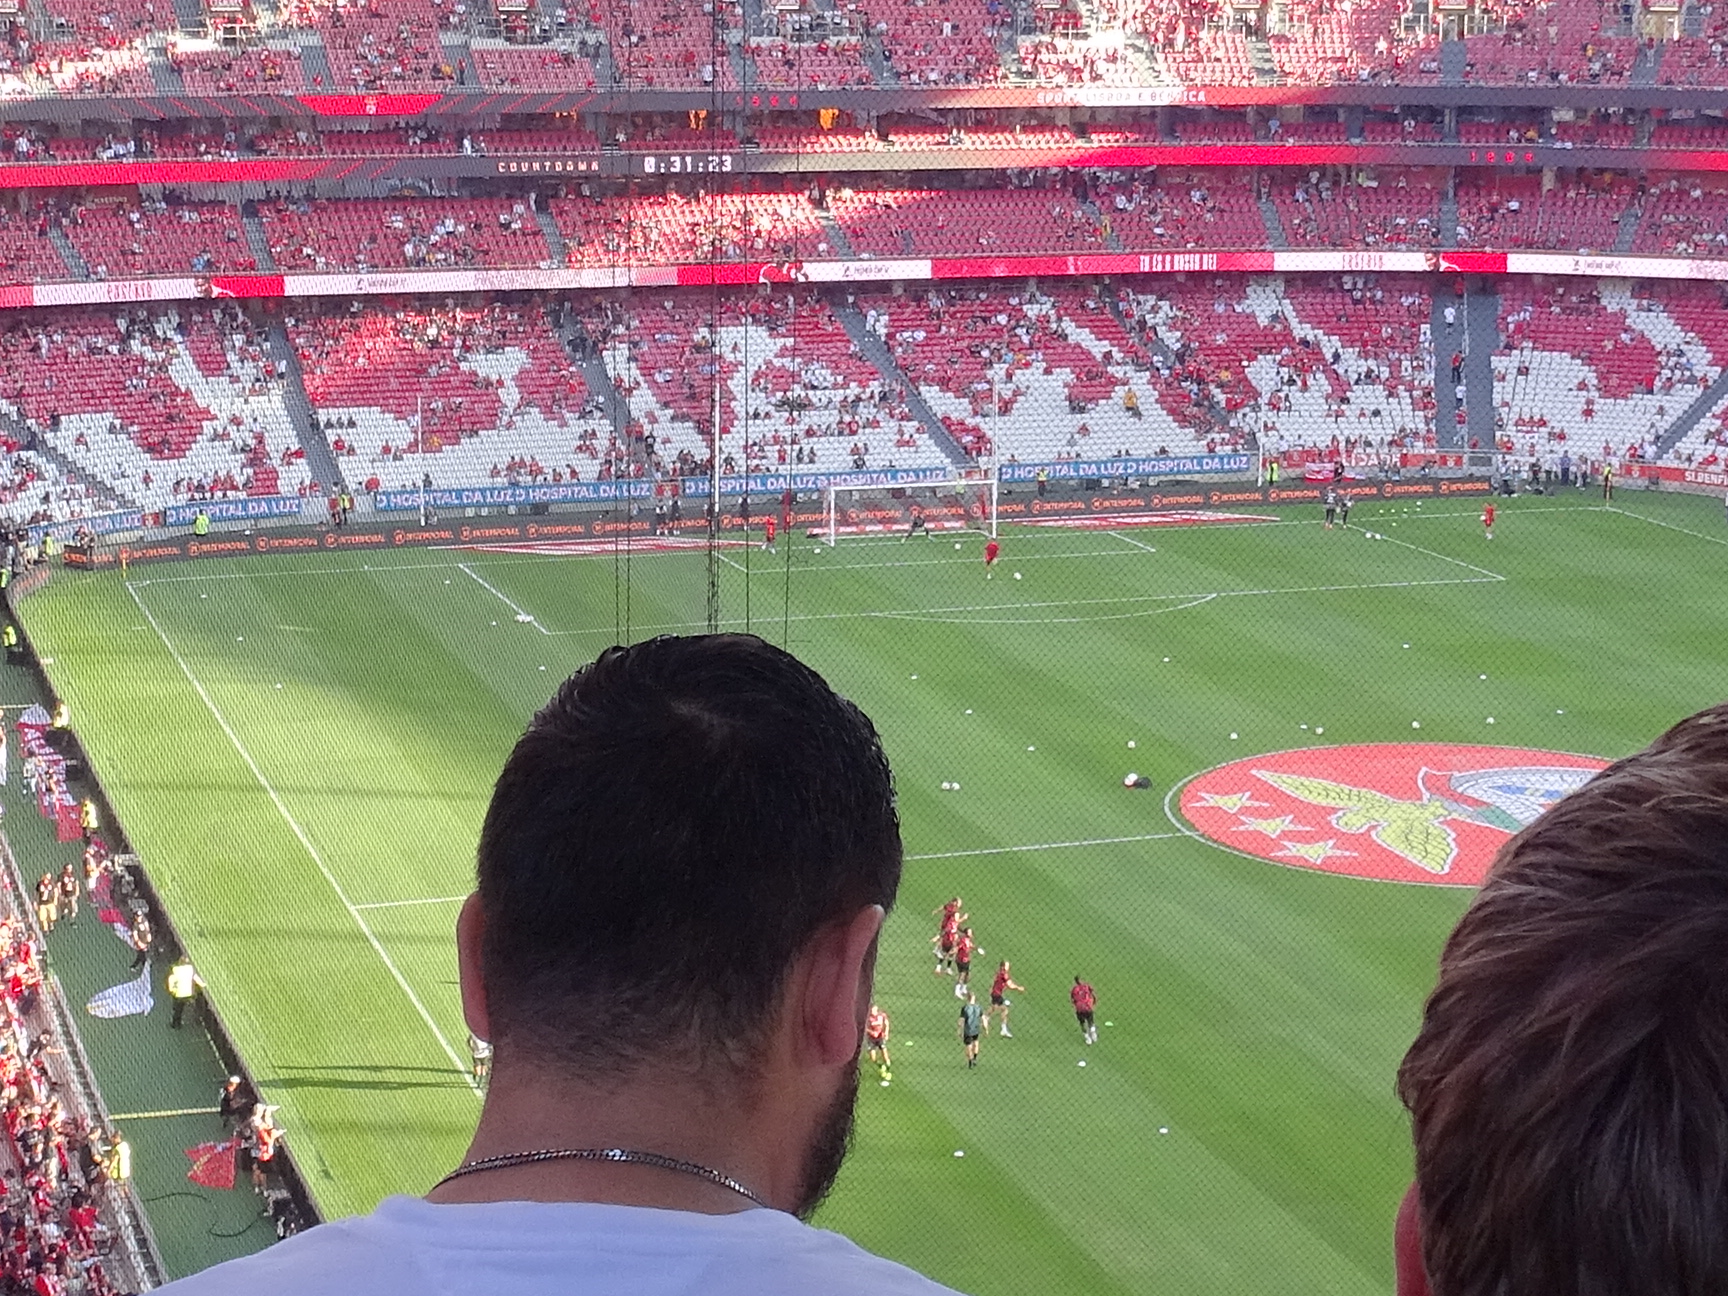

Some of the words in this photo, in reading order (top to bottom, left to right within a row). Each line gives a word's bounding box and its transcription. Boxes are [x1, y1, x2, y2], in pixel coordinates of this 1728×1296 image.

[497, 161, 600, 174] COUNTDOWN
[643, 155, 733, 174] 0:31:23
[1080, 460, 1099, 477] DA
[1101, 460, 1127, 475] LUZ
[1139, 456, 1202, 474] HOSPITAL
[1203, 455, 1222, 471] DA
[1223, 454, 1249, 469] LUZ
[699, 474, 766, 494] HSPITAL
[789, 473, 816, 490] LUZ
[917, 468, 946, 484] LUZ
